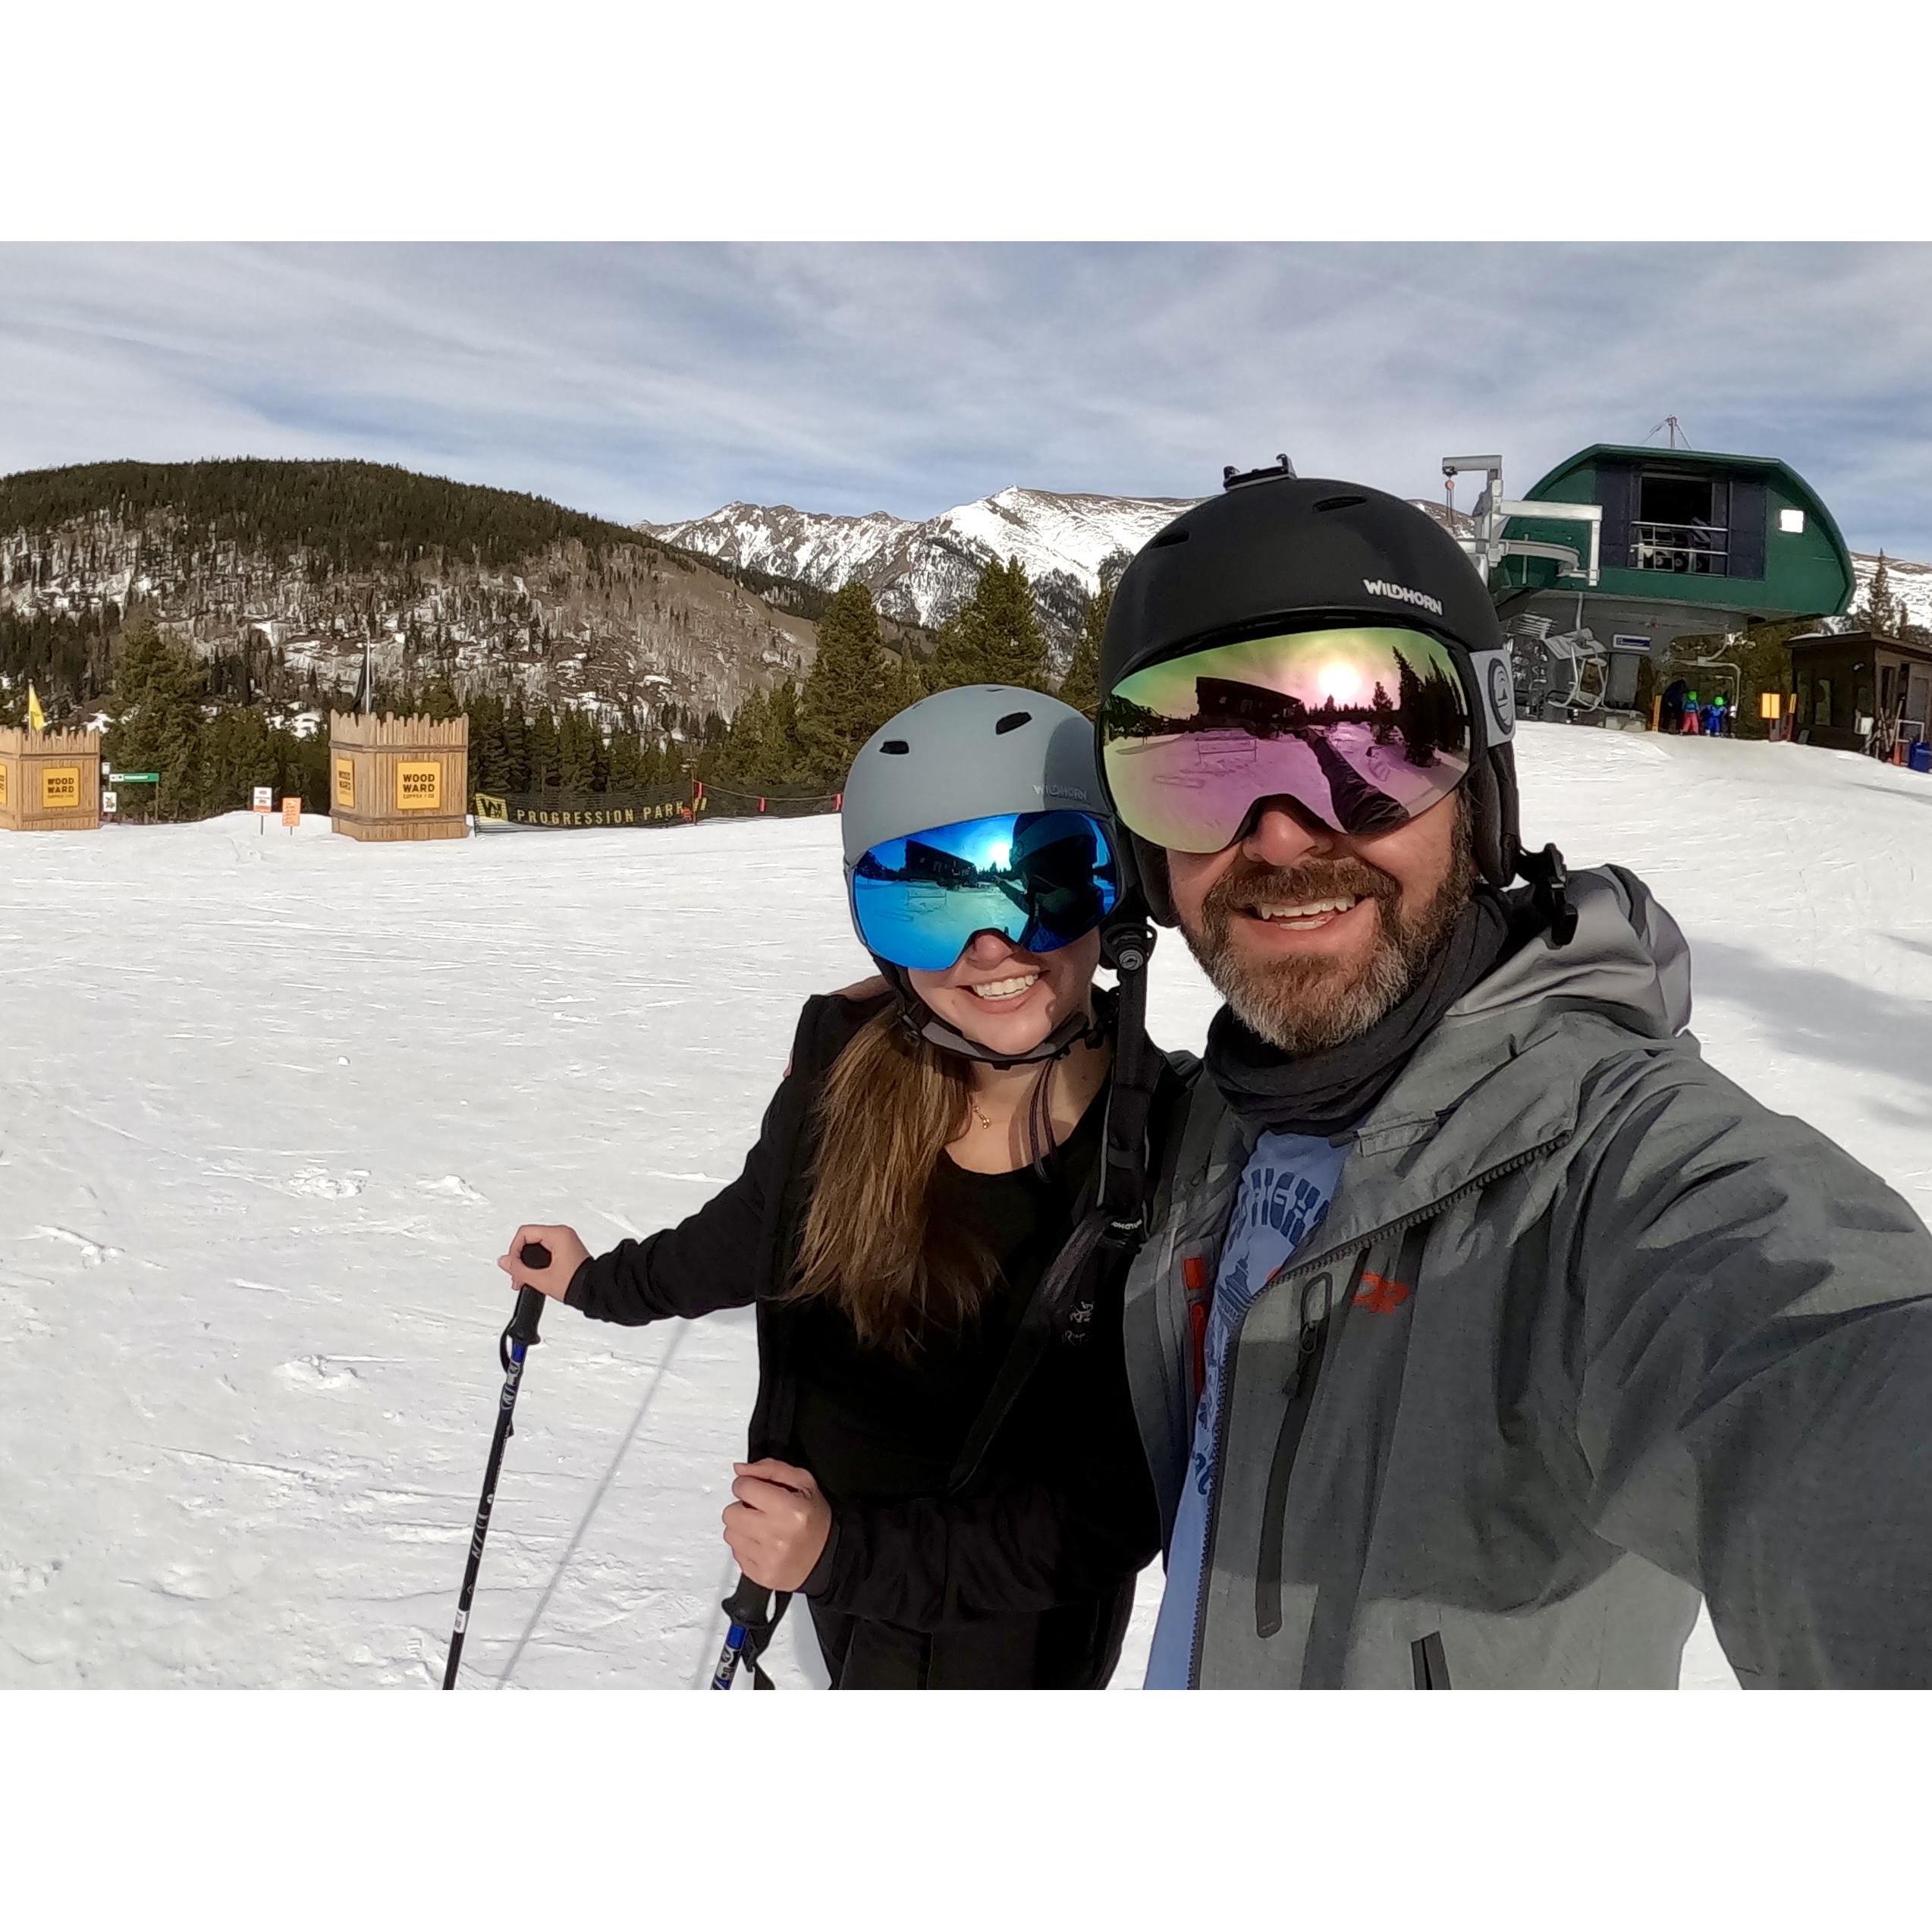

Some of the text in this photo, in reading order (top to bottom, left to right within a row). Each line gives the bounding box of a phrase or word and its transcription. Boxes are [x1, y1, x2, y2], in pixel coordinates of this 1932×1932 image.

[1363, 579, 1443, 616] WILDHORN
[403, 774, 435, 782] WOOD
[403, 784, 435, 793] WARD
[1032, 784, 1087, 801] WILDHORN
[517, 808, 634, 825] PROGRESSION
[642, 800, 683, 821] PARK
